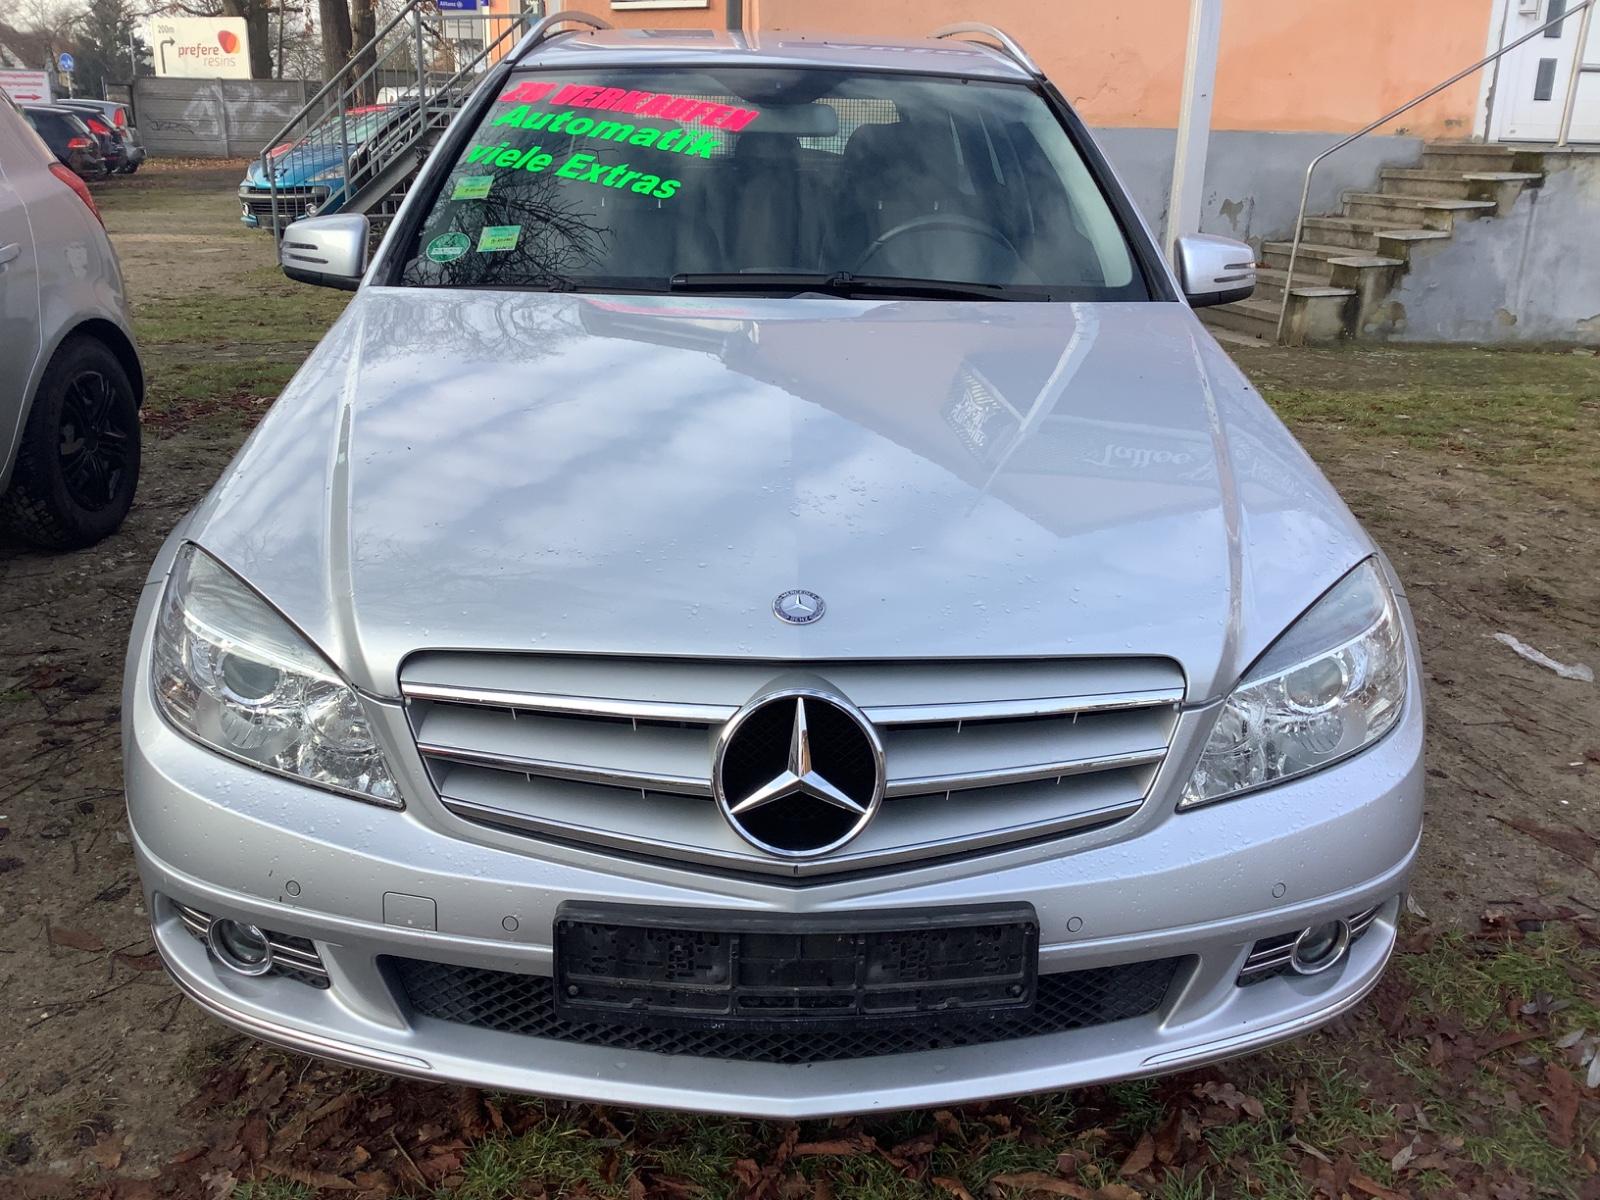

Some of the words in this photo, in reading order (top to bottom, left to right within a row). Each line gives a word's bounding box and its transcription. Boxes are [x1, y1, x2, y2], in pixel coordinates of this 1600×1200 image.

[157, 24, 175, 34] 200m
[178, 43, 219, 58] prefere
[203, 56, 236, 67] resins
[499, 82, 556, 103] ZU
[549, 83, 759, 132] VERKAUFEN
[491, 104, 721, 159] Automatik
[464, 141, 552, 172] viele
[554, 153, 681, 199] Extras
